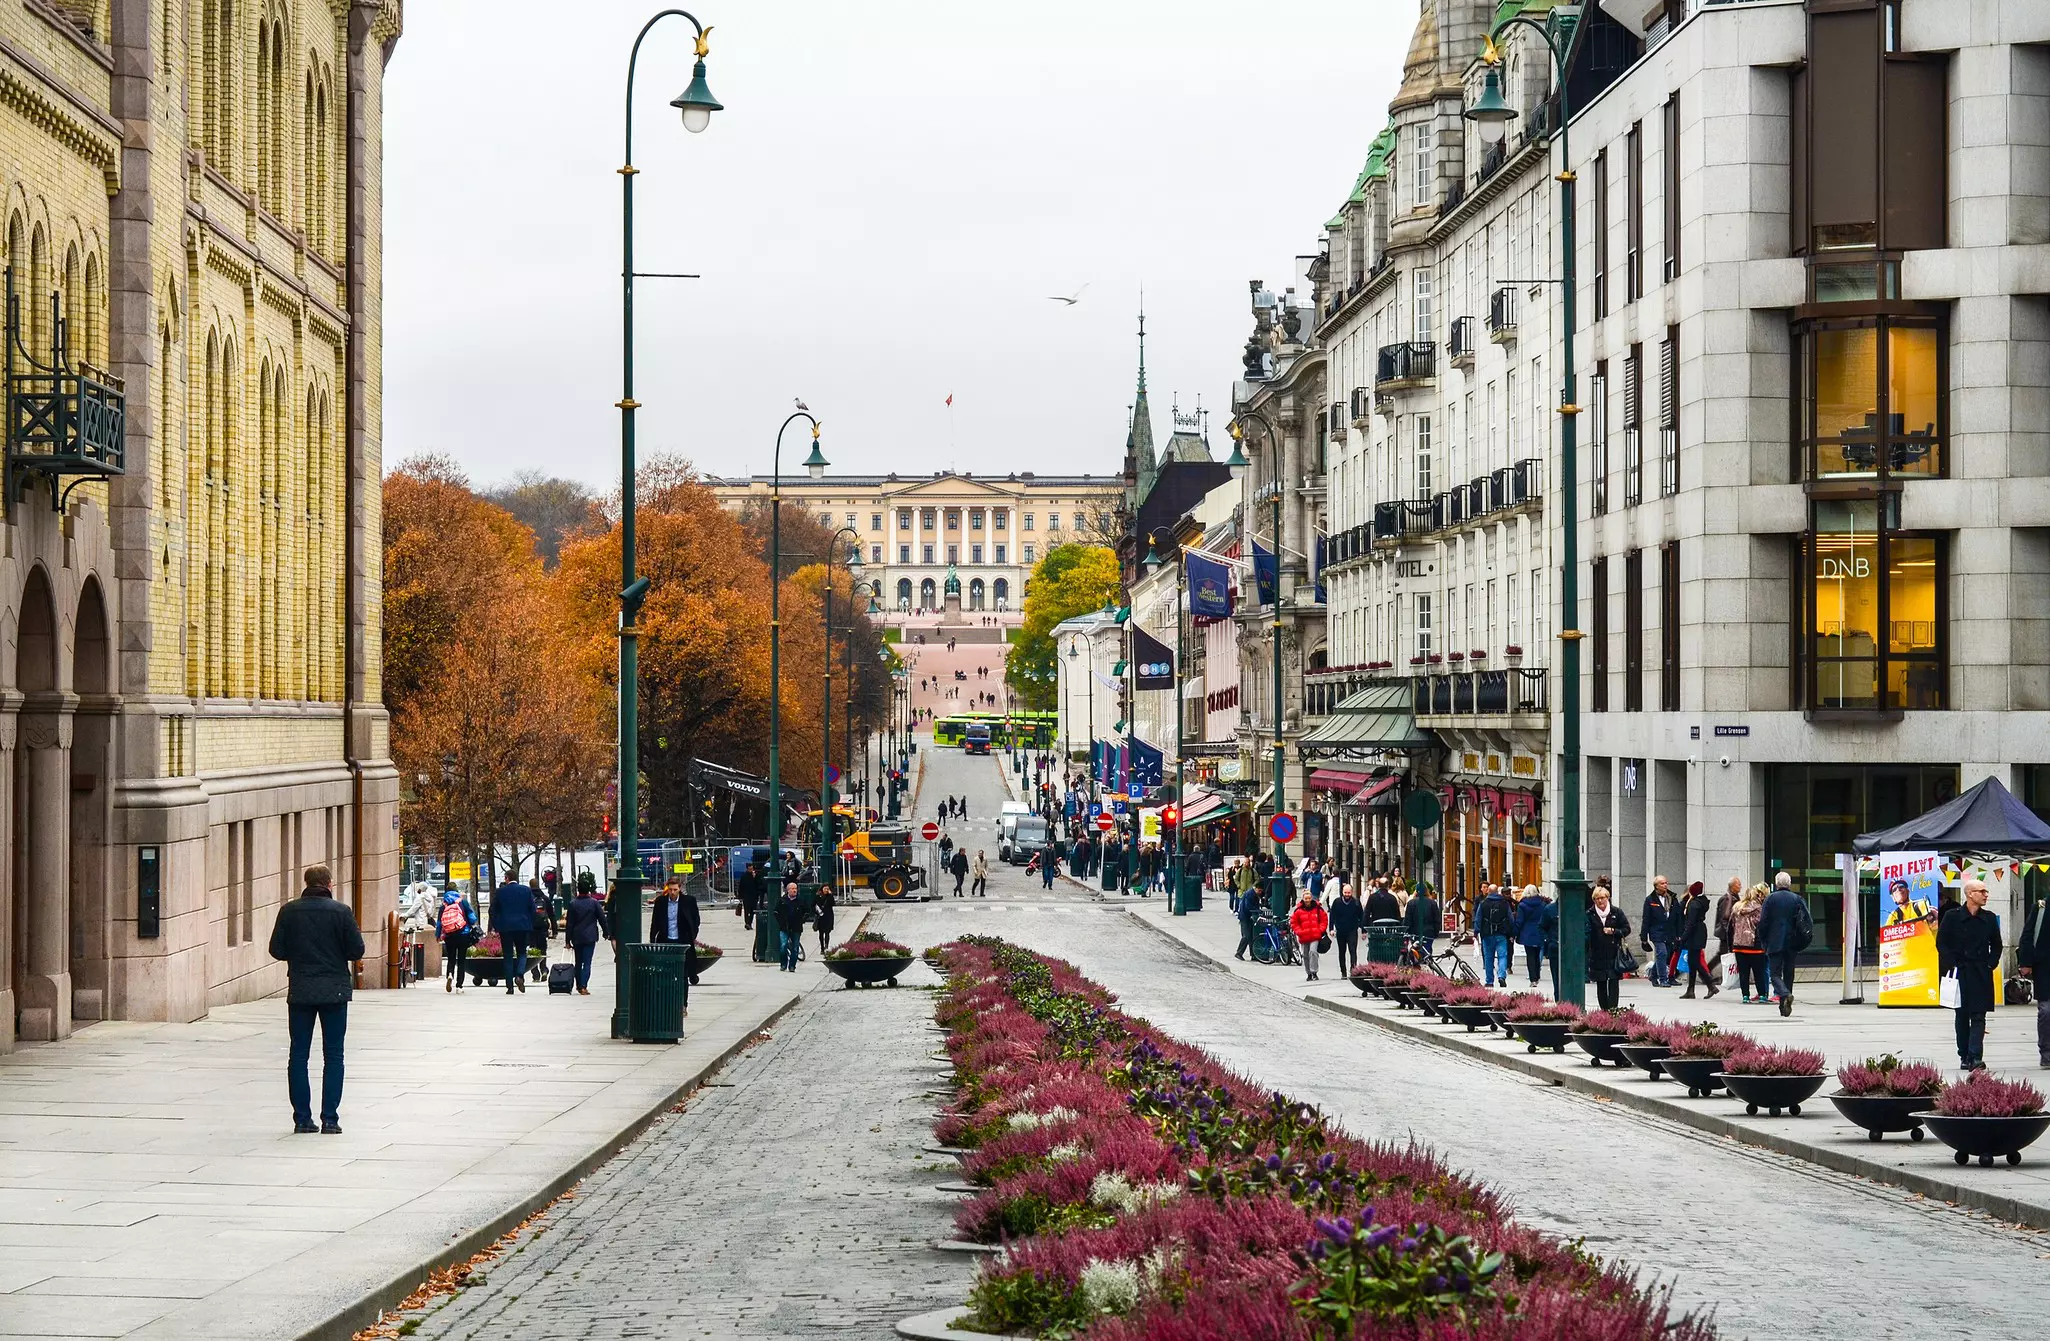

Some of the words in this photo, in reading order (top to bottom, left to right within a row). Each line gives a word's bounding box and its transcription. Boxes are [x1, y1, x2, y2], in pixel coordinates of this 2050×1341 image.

[1823, 558, 1870, 578] DNB
[1198, 592, 1224, 602] Western
[1201, 586, 1216, 595] Best
[1624, 766, 1637, 790] DNB
[726, 780, 761, 794] VOLVO
[1131, 785, 1139, 796] P
[1092, 806, 1099, 815] P
[1116, 802, 1123, 812] P
[1883, 863, 1903, 880] FRI
[1907, 857, 1934, 875] FLYT
[1911, 873, 1933, 891] Flex
[1883, 924, 1915, 937] OMEGA-3
